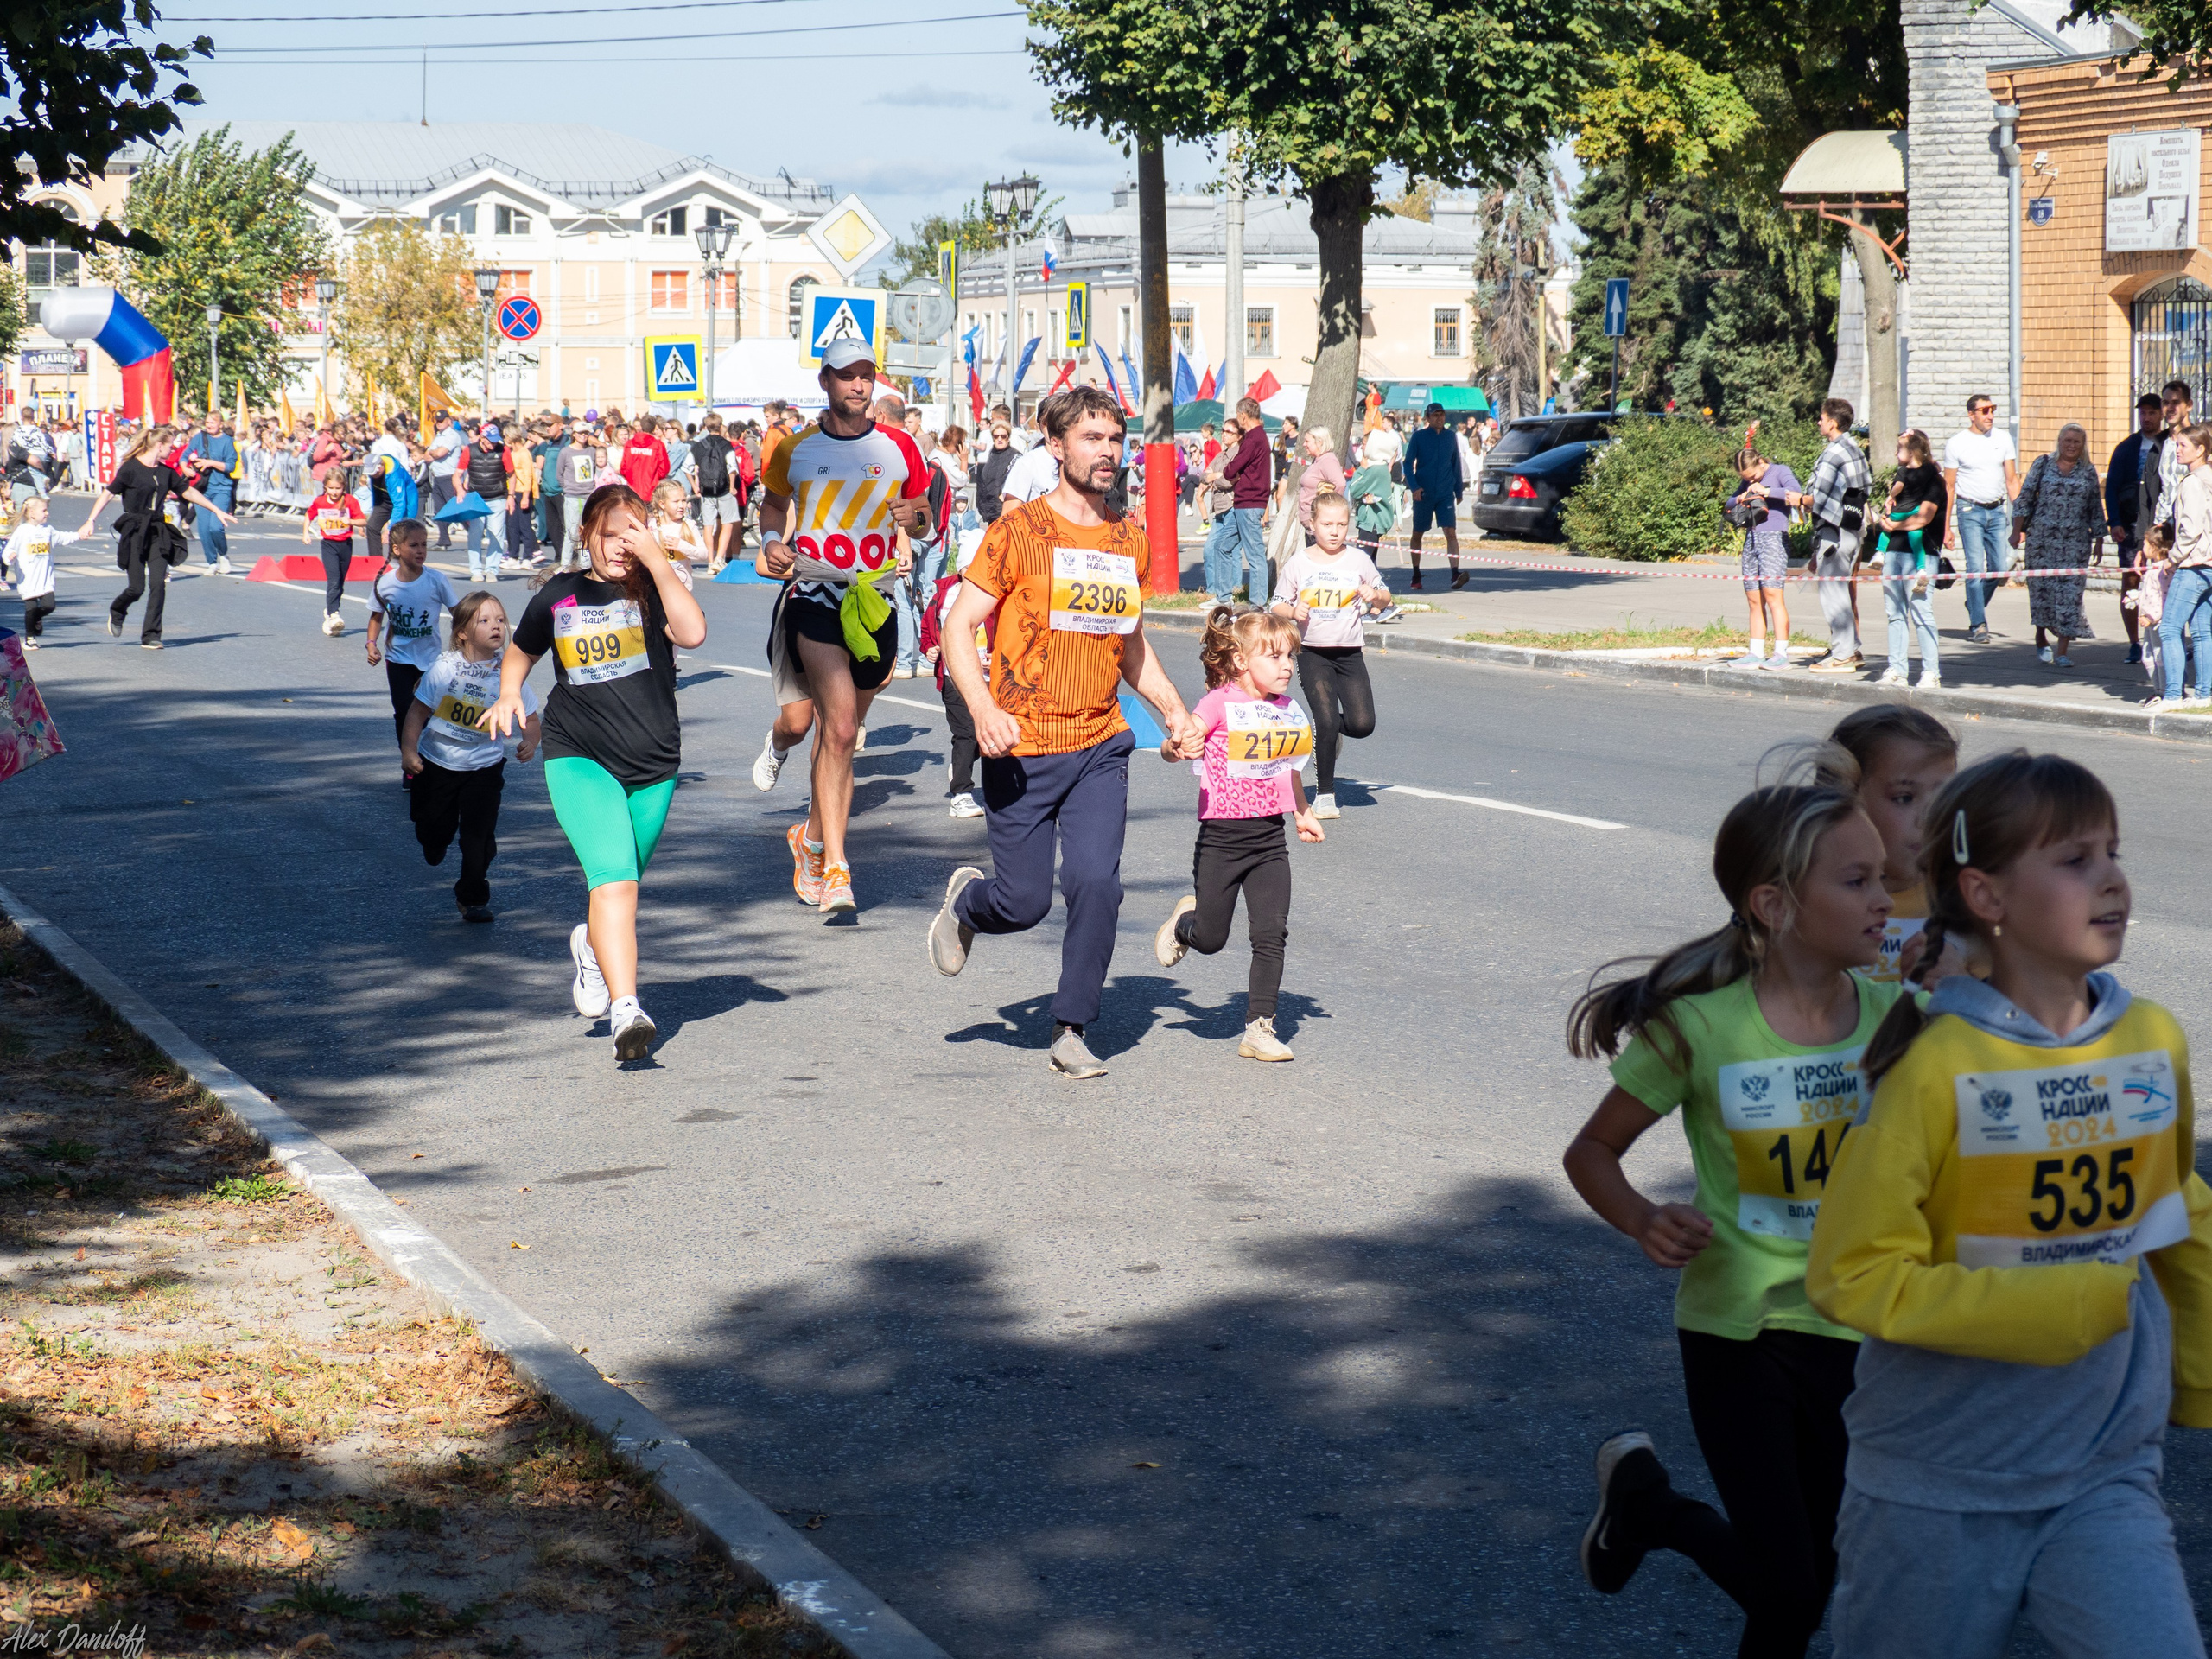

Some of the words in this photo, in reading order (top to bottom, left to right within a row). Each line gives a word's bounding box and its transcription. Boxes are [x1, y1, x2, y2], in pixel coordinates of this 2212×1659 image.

[101, 414, 112, 482] СТАРТ
[817, 467, 830, 475] GRi
[1086, 554, 1105, 563] КРОСС
[1086, 563, 1111, 572] НАЦИИ
[1067, 582, 1127, 614] 2396
[1314, 589, 1342, 607] 171
[581, 615, 610, 625] НАЦИИ
[1072, 615, 1117, 625] ВЛАДИМИРСКАЯ
[581, 624, 611, 634] 2024
[1082, 624, 1108, 632] ОБЛАСТЬ
[575, 633, 621, 664] 999
[580, 660, 626, 675] ВЛАДИМИРСКАЯ
[590, 671, 618, 681] ОБЛАСТЬ
[463, 689, 486, 699] НАЦИИ
[465, 683, 483, 692] КРОСС
[1256, 712, 1281, 721] НАЦИИ
[445, 722, 482, 738] ВЛАДИМИРСКАЯ
[450, 732, 474, 741] ОБЛАСТЬ
[1244, 731, 1300, 759] 2177
[1250, 757, 1290, 771] ВЛАДИМИРСКАЯ
[1261, 766, 1282, 777] ОБЛАСТЬ
[1794, 1061, 1844, 1083] КРОСС
[1795, 1077, 1858, 1101] НАЦИИ
[2036, 1074, 2093, 1099] КРОСС
[1799, 1096, 1859, 1123] 2024
[2041, 1092, 2111, 1120] НАЦИИ
[2046, 1115, 2117, 1147] 2024
[1769, 1122, 1852, 1194] 14
[2029, 1147, 2135, 1231] 535
